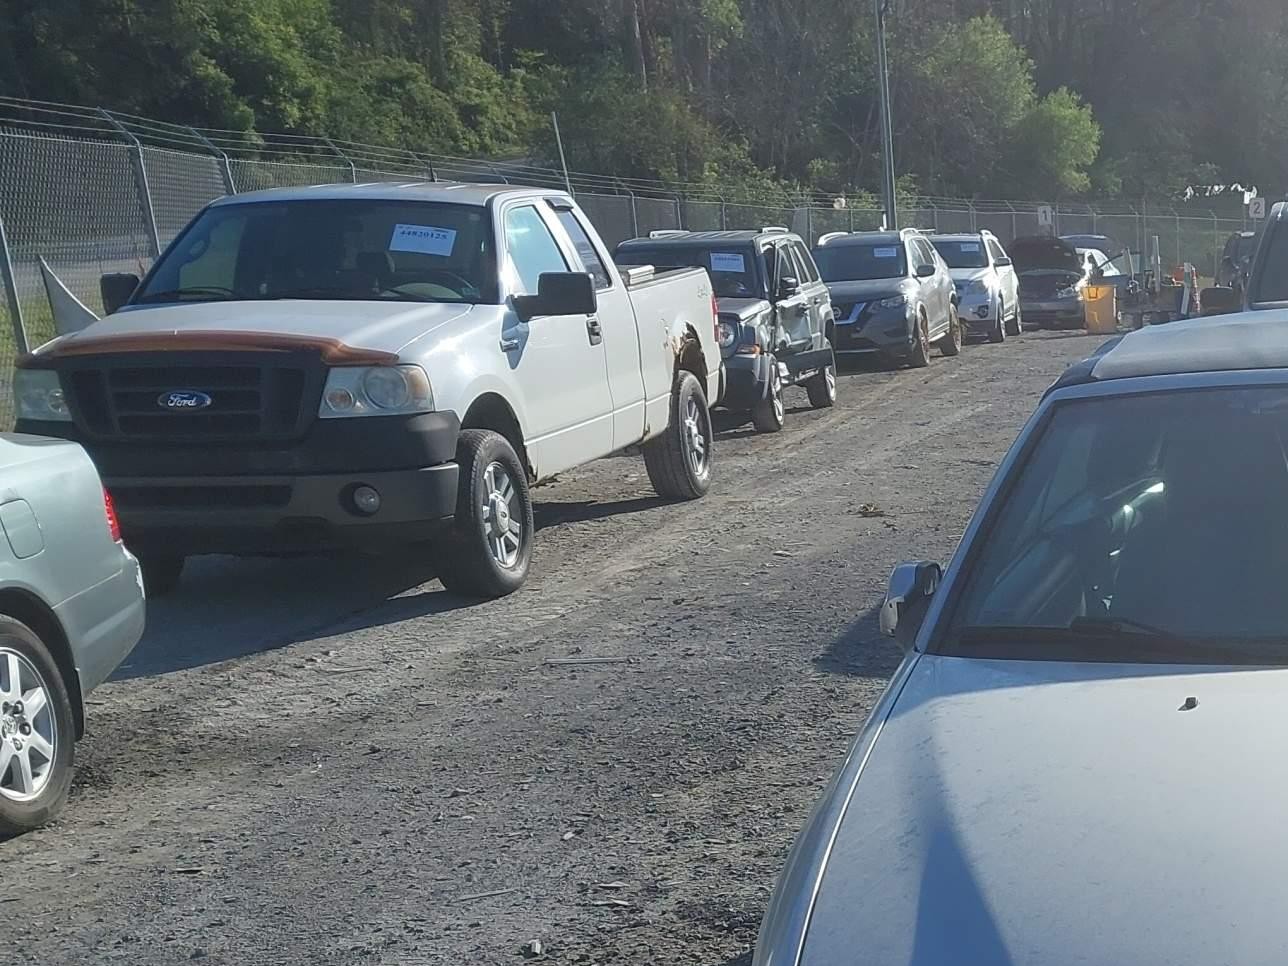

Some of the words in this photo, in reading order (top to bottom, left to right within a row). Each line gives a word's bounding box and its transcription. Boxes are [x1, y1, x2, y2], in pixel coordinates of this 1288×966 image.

[1042, 209, 1048, 221] 1
[1253, 201, 1261, 215] 2
[167, 393, 198, 407] Ford
